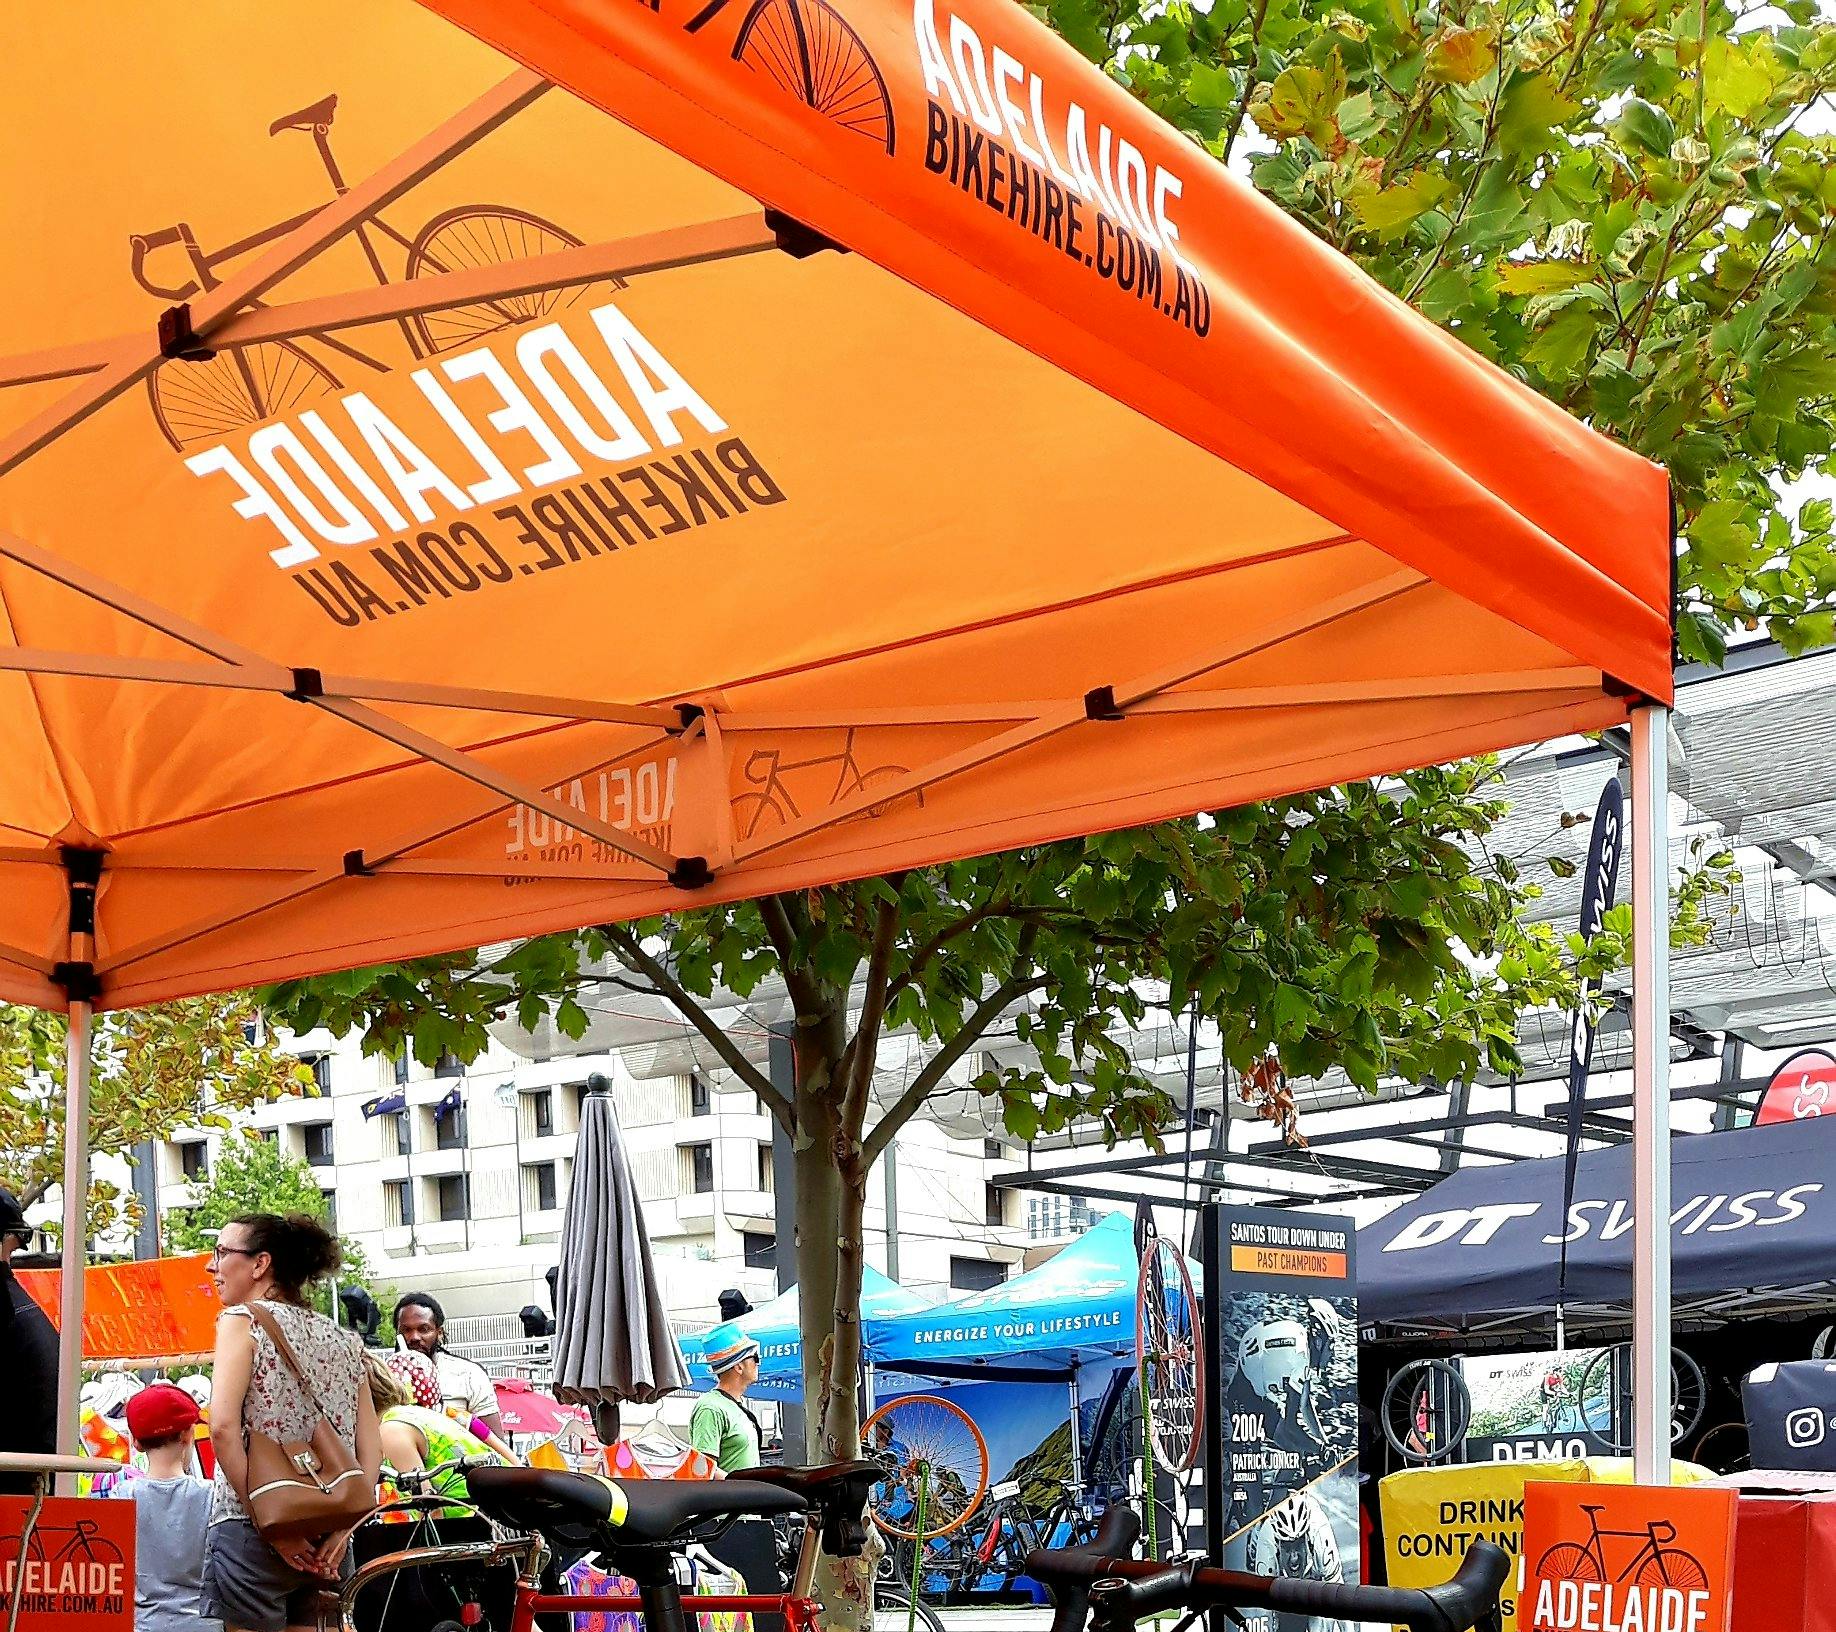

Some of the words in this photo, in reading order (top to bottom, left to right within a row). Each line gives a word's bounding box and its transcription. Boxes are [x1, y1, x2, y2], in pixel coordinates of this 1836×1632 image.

[912, 0, 1201, 280] ADELAIDE
[923, 98, 1212, 338] BIKEHIRE.COM.AU
[1231, 1222, 1266, 1244] SANTOS
[1266, 1225, 1290, 1246] TOUR
[1290, 1228, 1318, 1248] DOWN
[1318, 1230, 1346, 1250] UNDER
[1381, 1202, 1543, 1254] DT
[1257, 1251, 1279, 1270] PAST
[1280, 1253, 1328, 1273] CHAMPIONS
[913, 1325, 988, 1345] ENERGIZE
[993, 1320, 1035, 1339] YOUR
[1041, 1311, 1122, 1335] LIFESTYLE
[758, 1343, 800, 1360] LIFEST
[1231, 1413, 1266, 1442] 2004
[1232, 1452, 1268, 1471] PATRICK
[1268, 1452, 1300, 1470] JONKER
[1492, 1437, 1587, 1462] DEMO
[1439, 1498, 1525, 1525] DRINK
